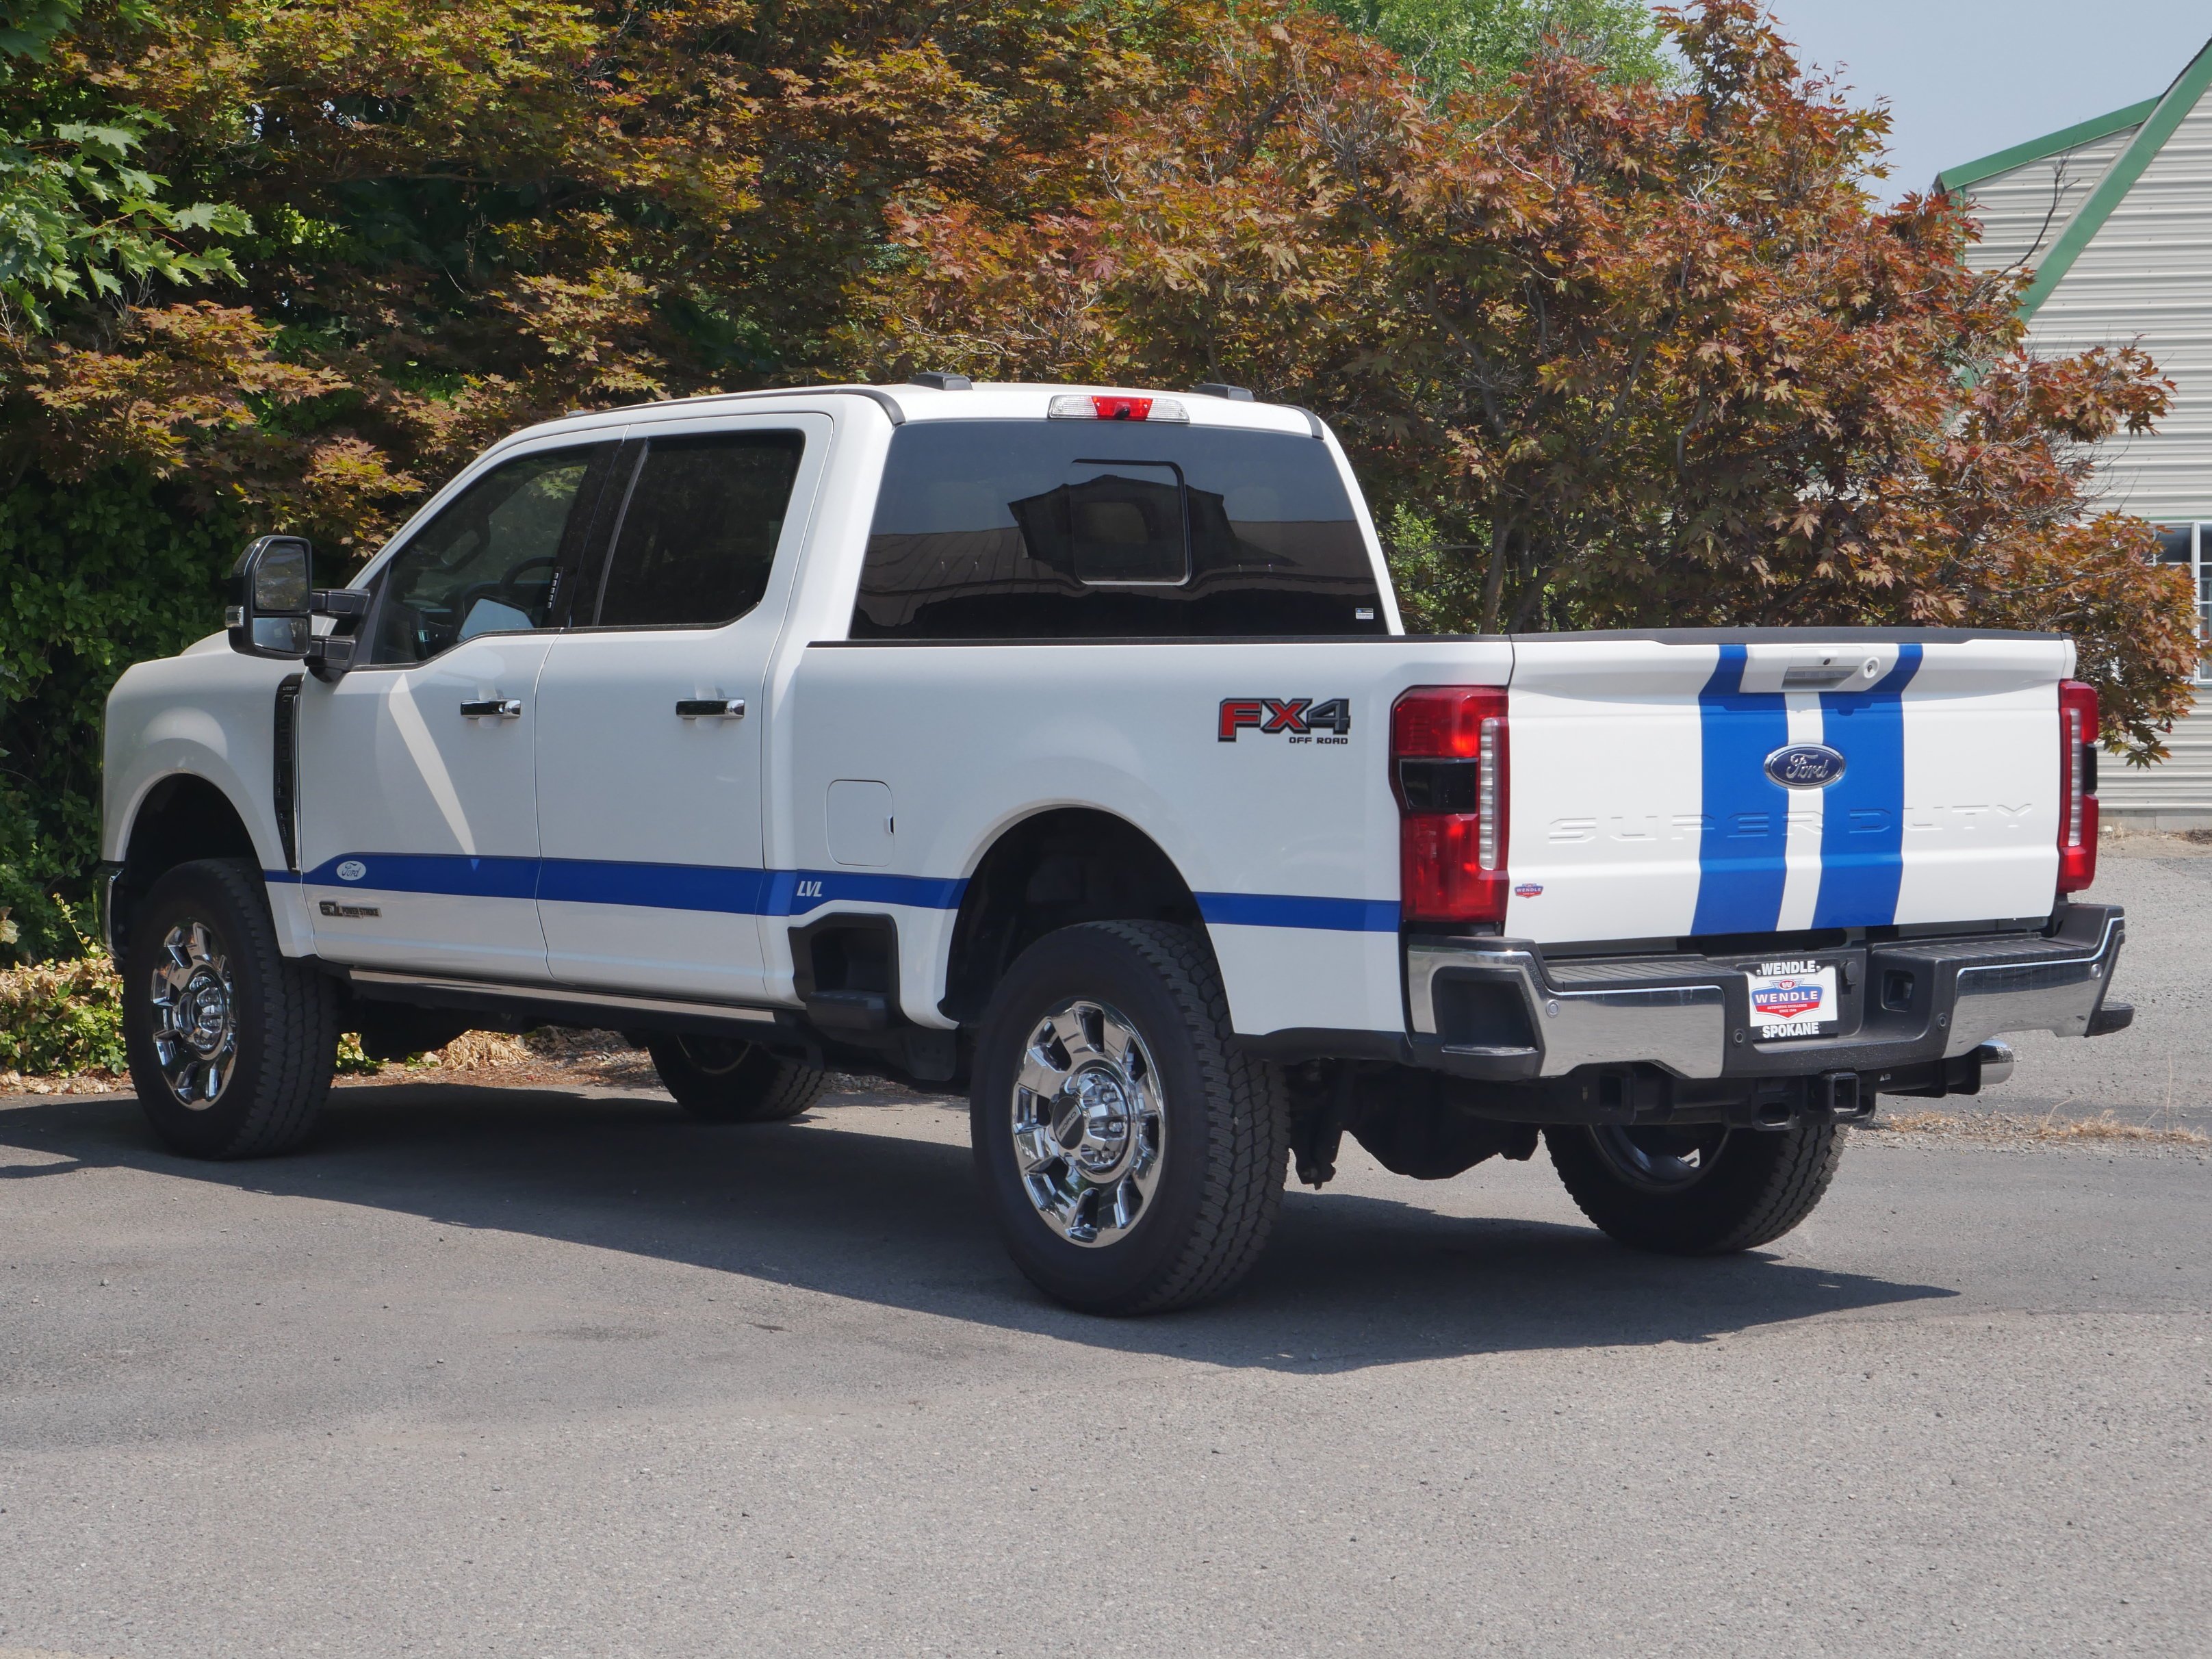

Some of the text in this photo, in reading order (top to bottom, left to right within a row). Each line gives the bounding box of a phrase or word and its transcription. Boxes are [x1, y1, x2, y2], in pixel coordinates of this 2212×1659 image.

[1218, 698, 1351, 742] FX4
[1786, 754, 1829, 779] Ford
[1548, 803, 2032, 844] SUPER DUTY
[342, 862, 361, 877] Ford
[796, 880, 823, 897] LVL
[1761, 960, 1816, 975] WENDLE
[1755, 990, 1818, 1003] WENDLE
[1762, 1022, 1820, 1038] SPOKANE
